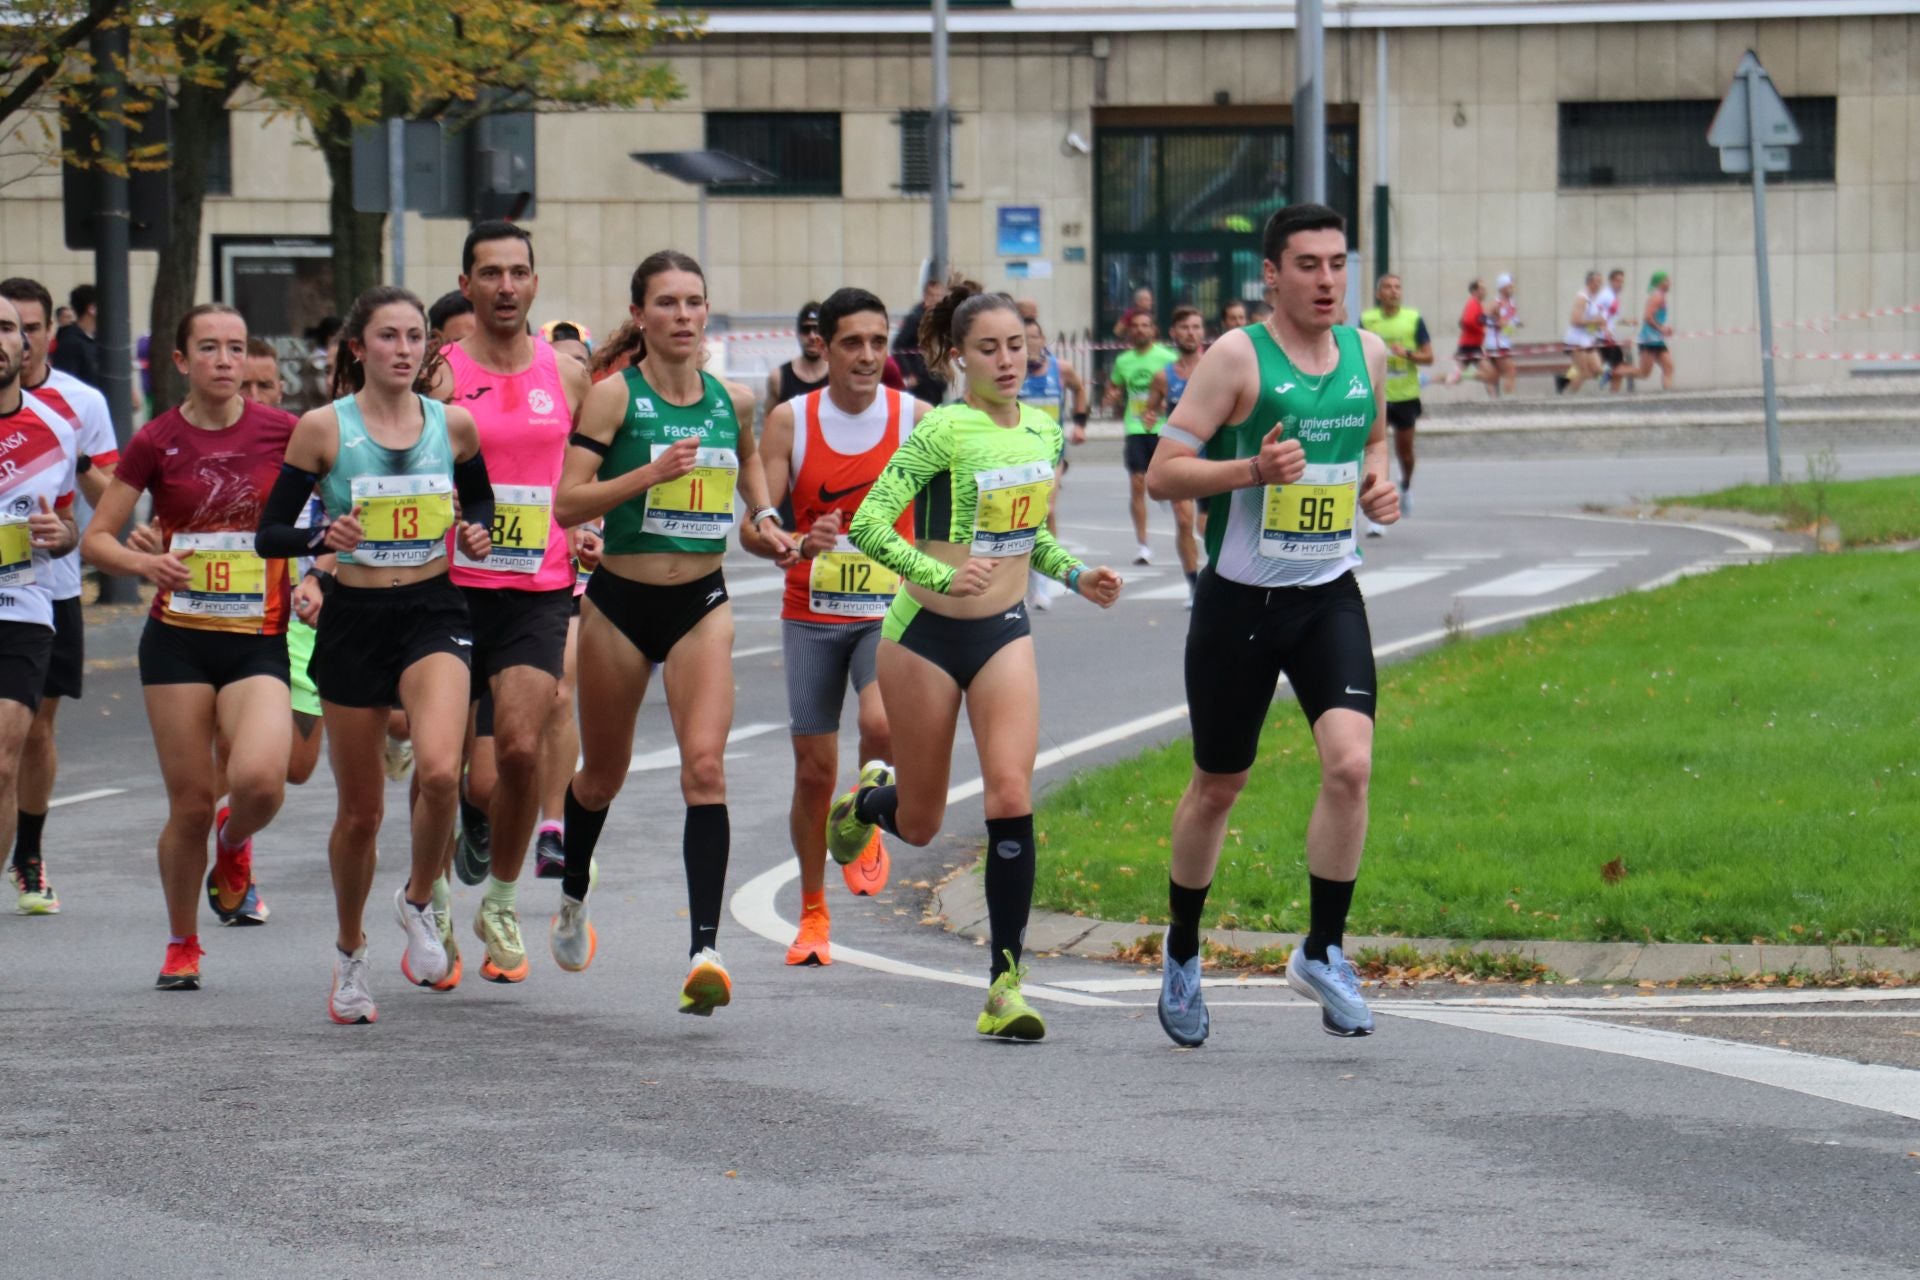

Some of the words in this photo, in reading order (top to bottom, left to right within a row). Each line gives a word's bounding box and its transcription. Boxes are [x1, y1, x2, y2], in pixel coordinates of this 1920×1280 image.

[1299, 414, 1365, 429] universidad
[1307, 429, 1331, 442] león
[689, 478, 703, 511] 11
[392, 507, 418, 539] 13
[1010, 496, 1030, 529] 12
[1300, 498, 1334, 531] 96
[491, 515, 522, 546] 84
[681, 522, 721, 533] HYUNDAI
[491, 556, 535, 567] HYUNDAI
[206, 562, 229, 591] 19
[840, 563, 871, 592] 112
[205, 603, 249, 611] HYUNDAI
